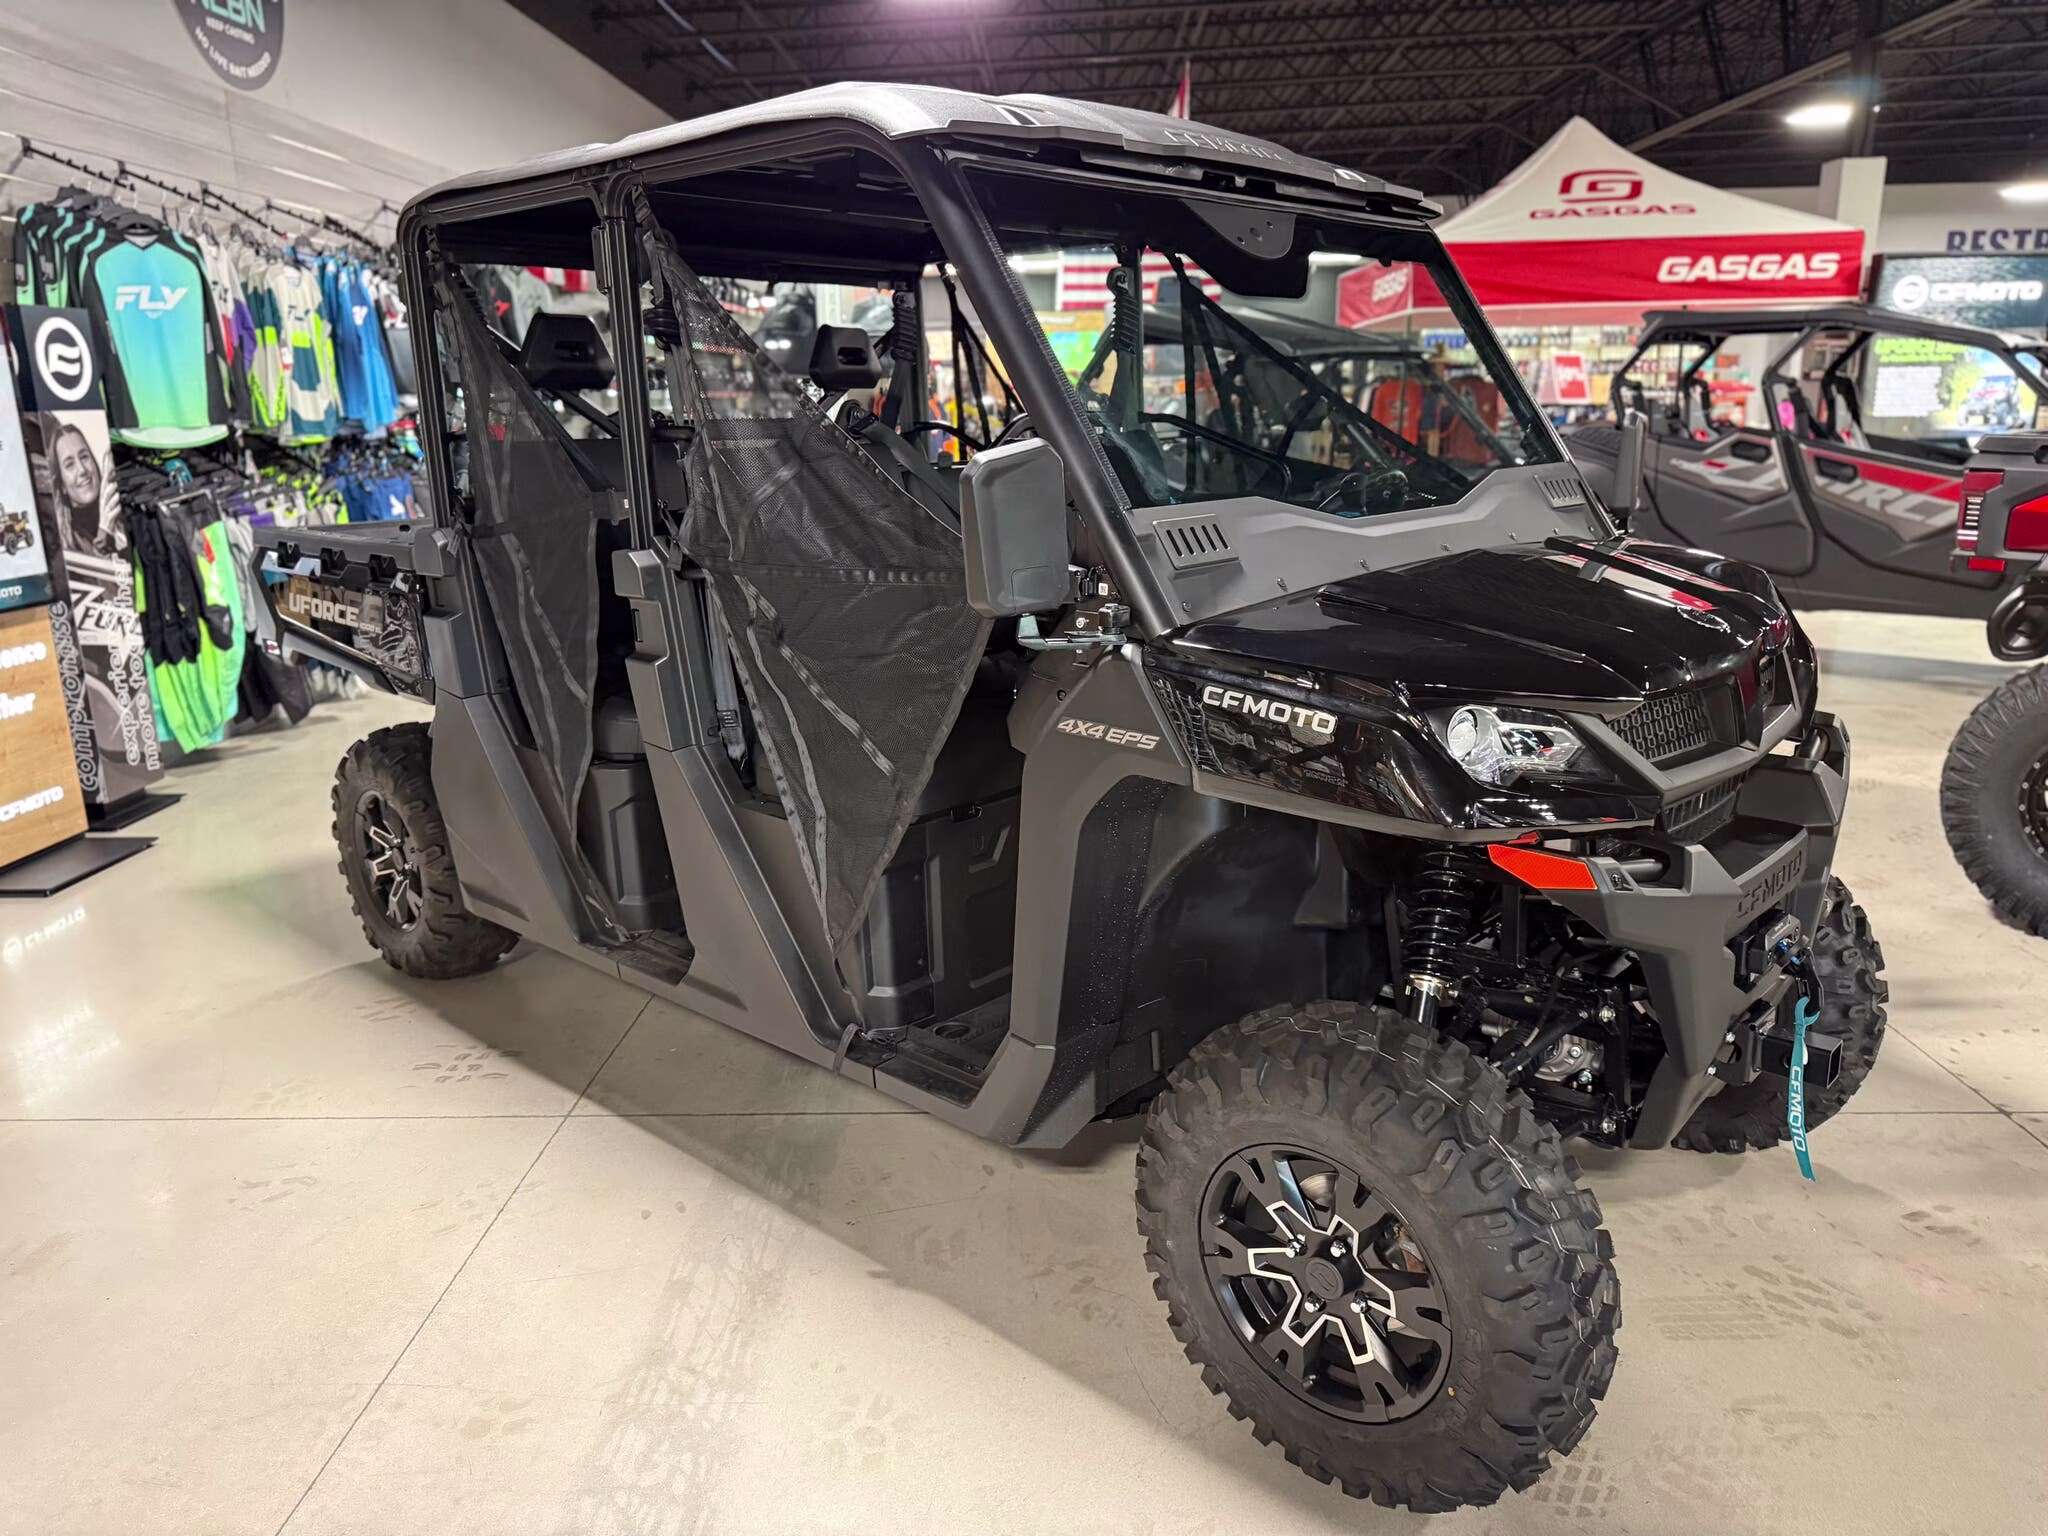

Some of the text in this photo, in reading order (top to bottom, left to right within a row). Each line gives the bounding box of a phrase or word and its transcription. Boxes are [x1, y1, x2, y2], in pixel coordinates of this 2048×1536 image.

[1529, 204, 1697, 220] GASGAS
[1656, 252, 1840, 283] GASGAS
[115, 285, 189, 311] FLY
[1931, 280, 2043, 301] CFMOTO
[289, 592, 359, 628] UFORCE
[52, 600, 99, 791] compromise
[1202, 686, 1338, 734] CFMOTO
[136, 692, 160, 771] more
[1057, 718, 1161, 750] 4X4 EPS
[1736, 849, 1802, 919] CFMOTO
[1787, 1065, 1806, 1152] CFMOTO
